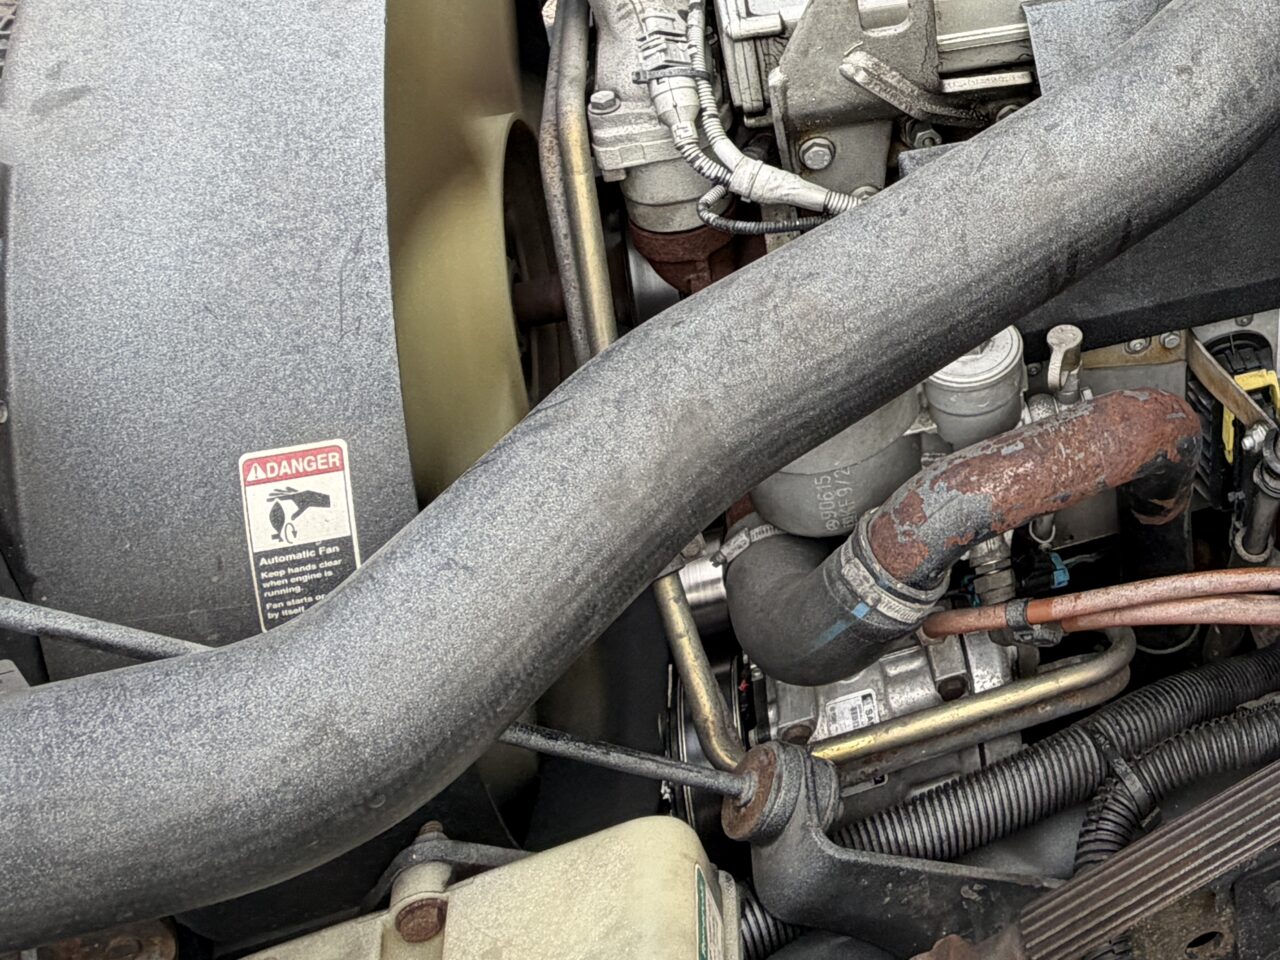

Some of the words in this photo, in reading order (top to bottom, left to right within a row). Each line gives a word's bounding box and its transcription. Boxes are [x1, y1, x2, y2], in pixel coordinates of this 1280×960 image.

[266, 452, 340, 478] DANGER
[260, 549, 316, 566] Automatic
[319, 545, 340, 555] Fan
[261, 569, 286, 580] Keep
[288, 563, 317, 574] hands
[319, 559, 343, 568] clear
[262, 578, 288, 588] when
[290, 572, 322, 583] engine
[324, 569, 334, 577] is
[264, 585, 304, 597] running.
[266, 601, 284, 610] Fan
[286, 596, 314, 607] starts
[267, 611, 279, 620] by
